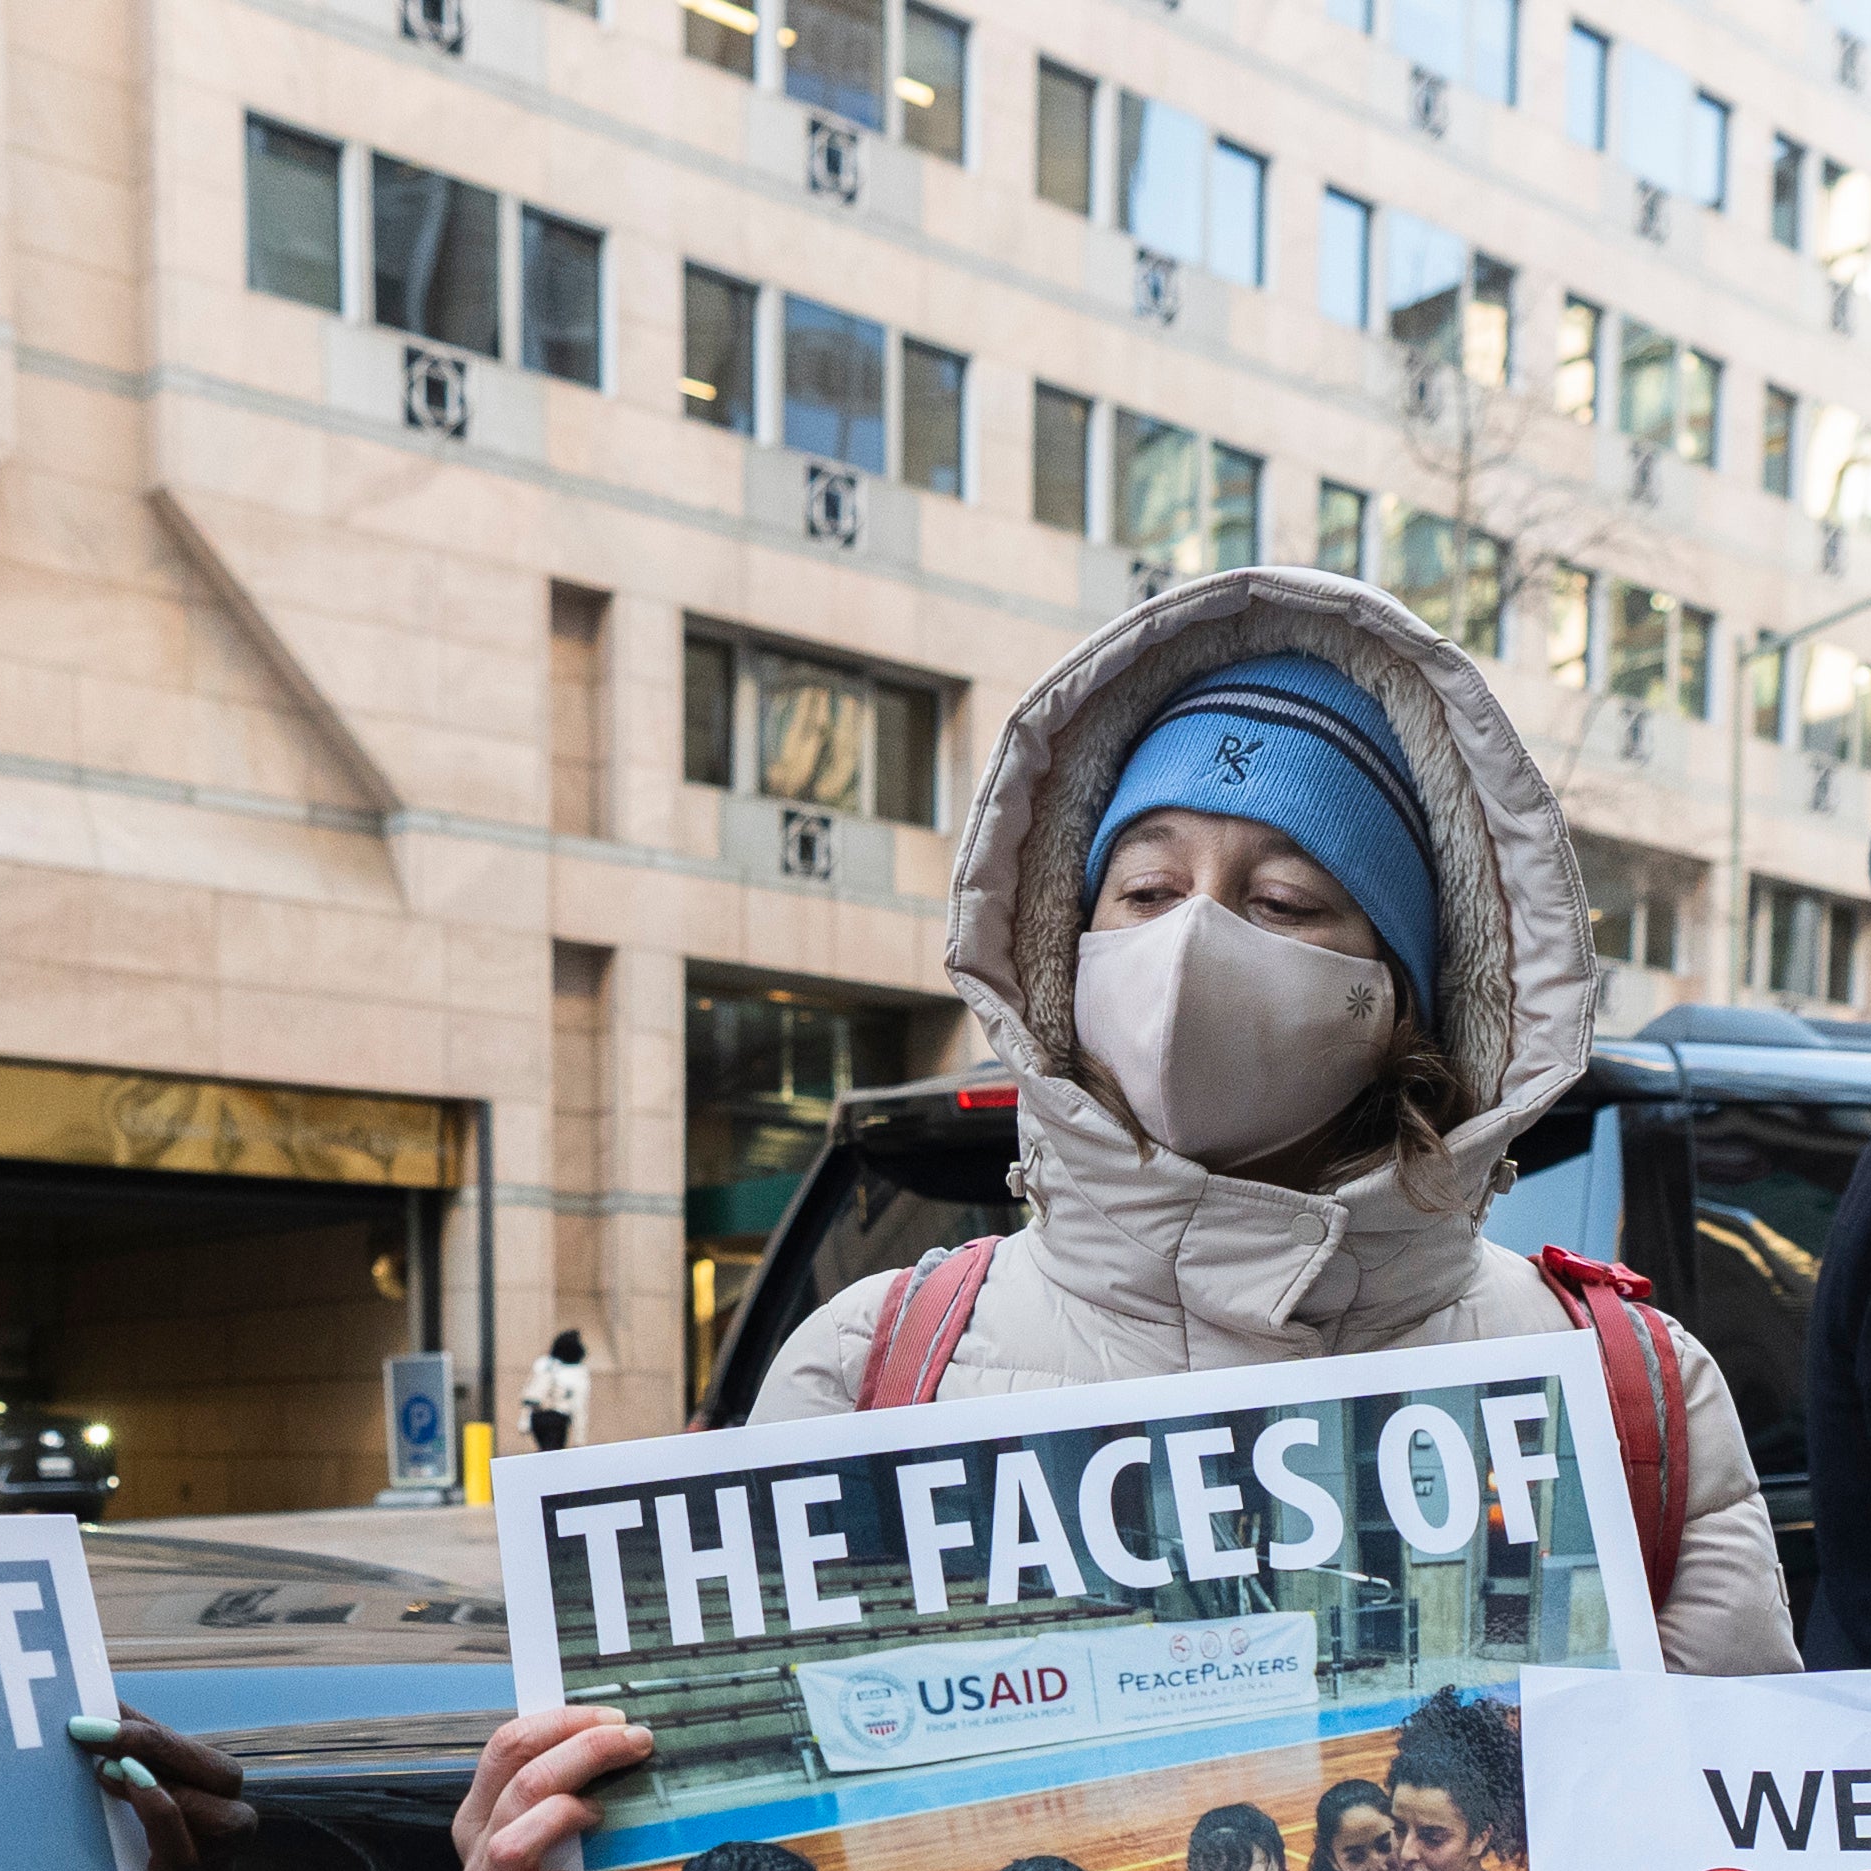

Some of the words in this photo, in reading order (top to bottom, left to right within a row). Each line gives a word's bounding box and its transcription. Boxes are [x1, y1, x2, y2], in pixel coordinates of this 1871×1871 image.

[555, 1472, 862, 1656] THE
[895, 1416, 1346, 1614] FACES
[1377, 1391, 1561, 1555] OF
[917, 1666, 1069, 1716] USAID
[1118, 1656, 1299, 1694] PEACEPLAYERS
